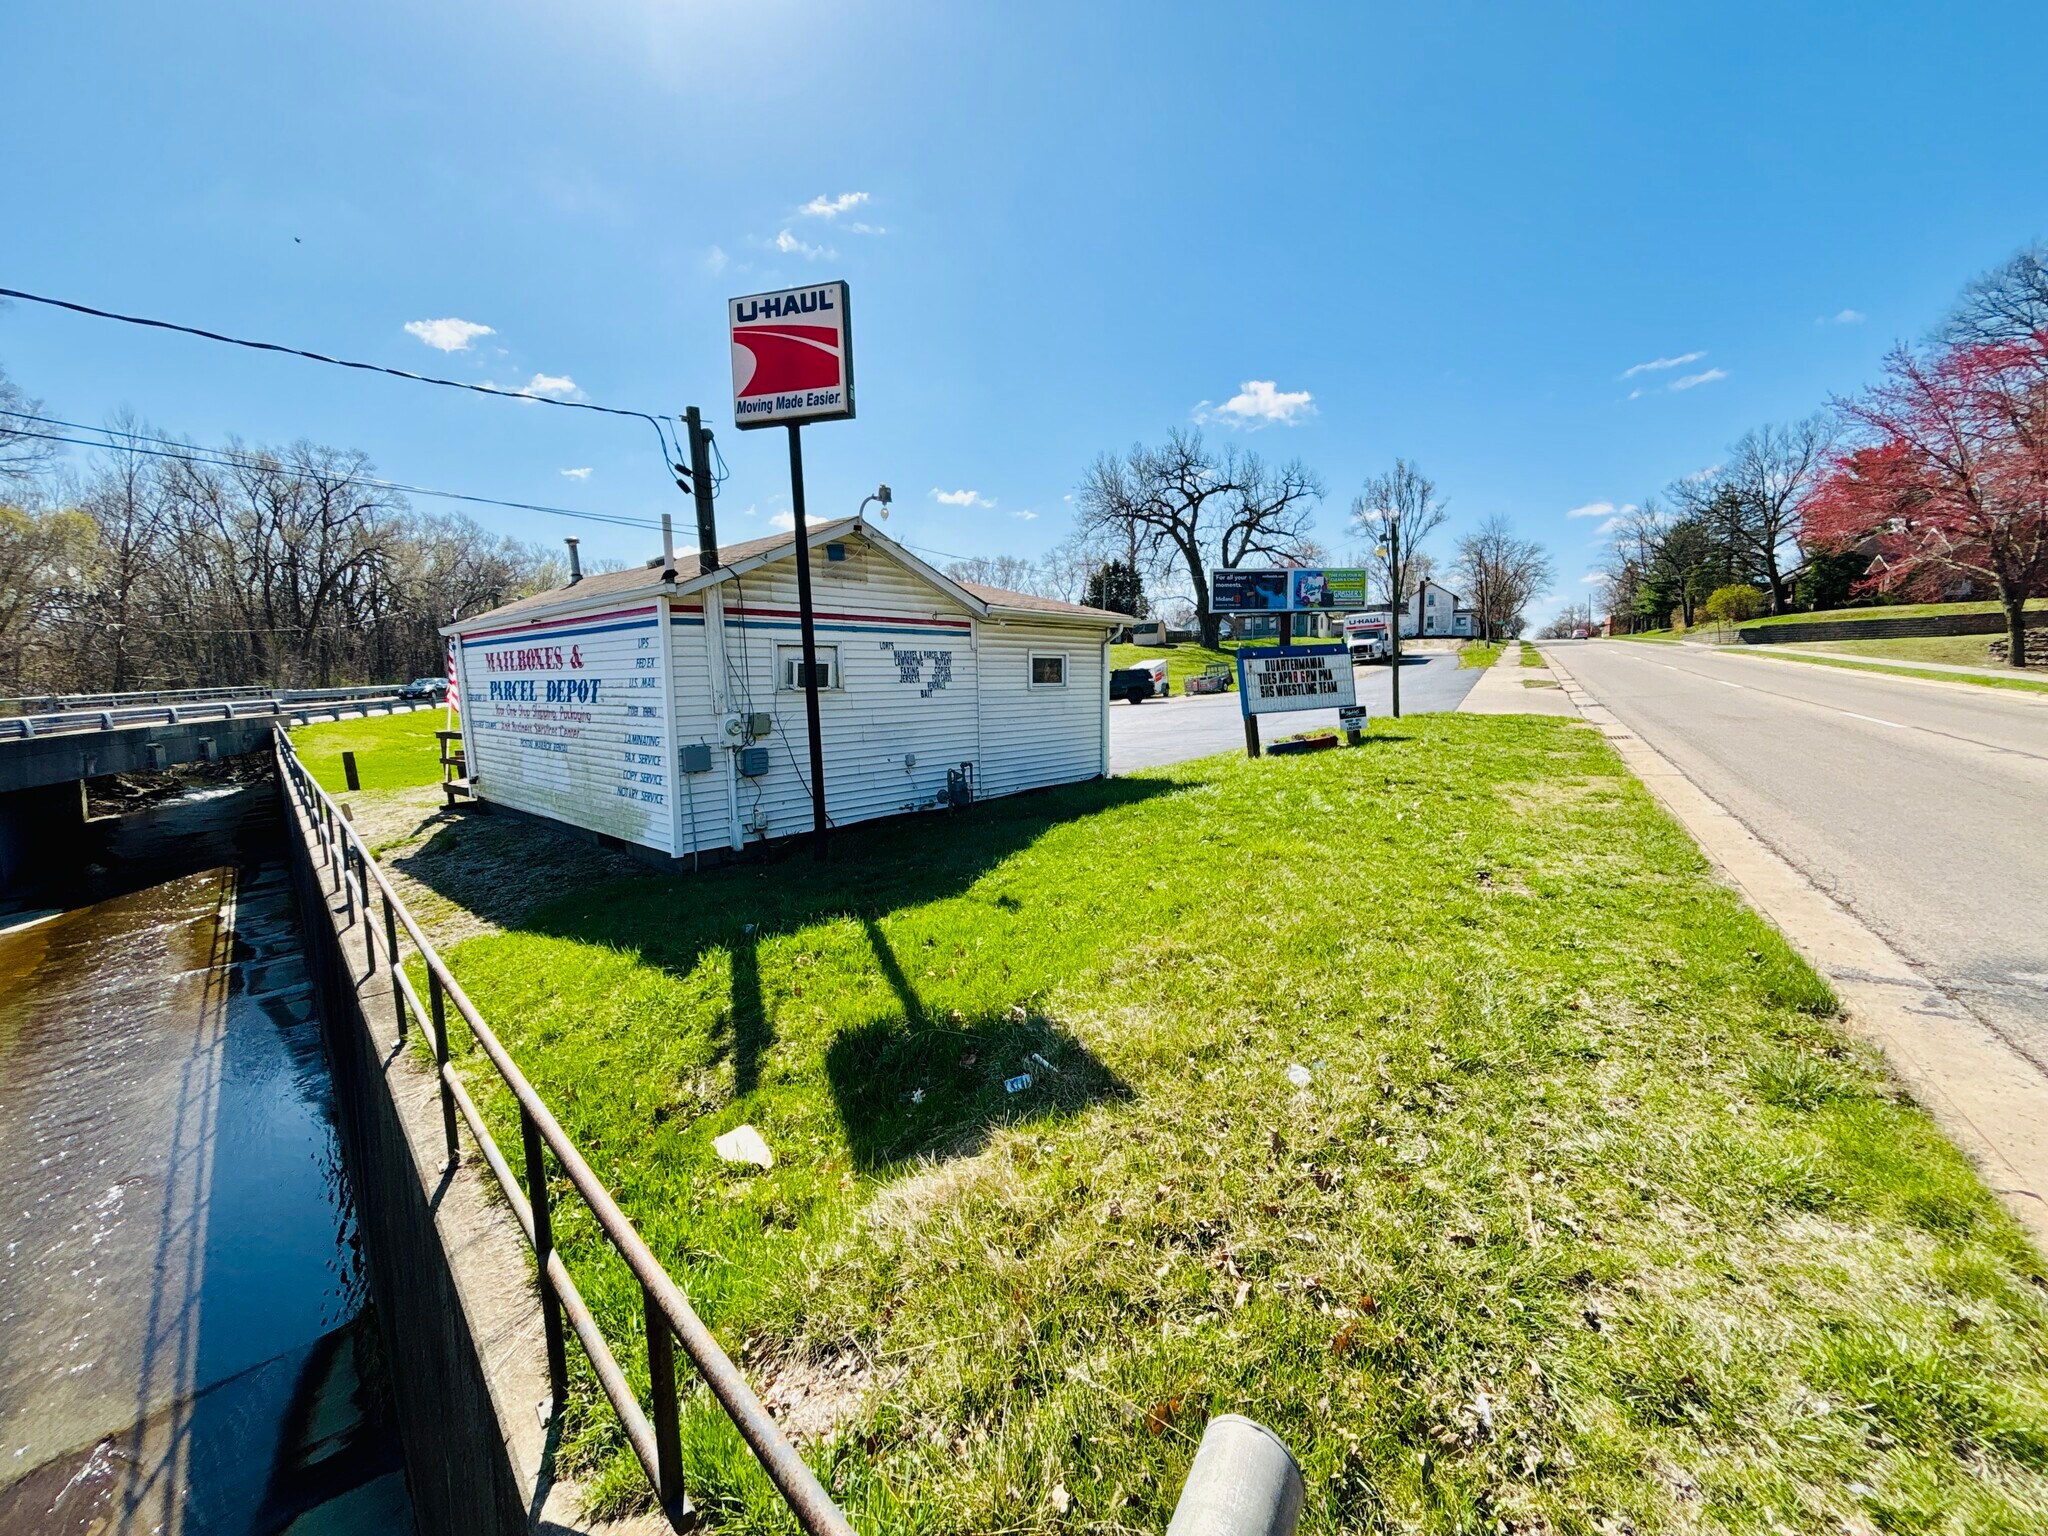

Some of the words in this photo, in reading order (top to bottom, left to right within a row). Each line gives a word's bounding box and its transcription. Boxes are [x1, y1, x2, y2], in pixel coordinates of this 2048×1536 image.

[737, 400, 773, 414] Moving
[775, 395, 803, 409] Made
[637, 637, 649, 649] UPS
[485, 646, 564, 672] MAILBOXES
[569, 644, 584, 669] &
[900, 666, 919, 676] FAXING
[1257, 672, 1277, 685] TUES
[490, 680, 538, 702] PARCEL
[546, 679, 602, 703] DEPOT
[920, 689, 933, 698] BAIT
[1260, 684, 1275, 698] SHS
[1276, 682, 1317, 697] WRESTLING
[1318, 681, 1338, 694] TEAM
[624, 733, 660, 747] LAMINATING
[625, 752, 636, 763] FAX
[639, 754, 661, 766] SERVICE
[622, 769, 638, 781] COPY
[640, 772, 663, 785] SERVICE
[641, 790, 664, 804] SERVICE
